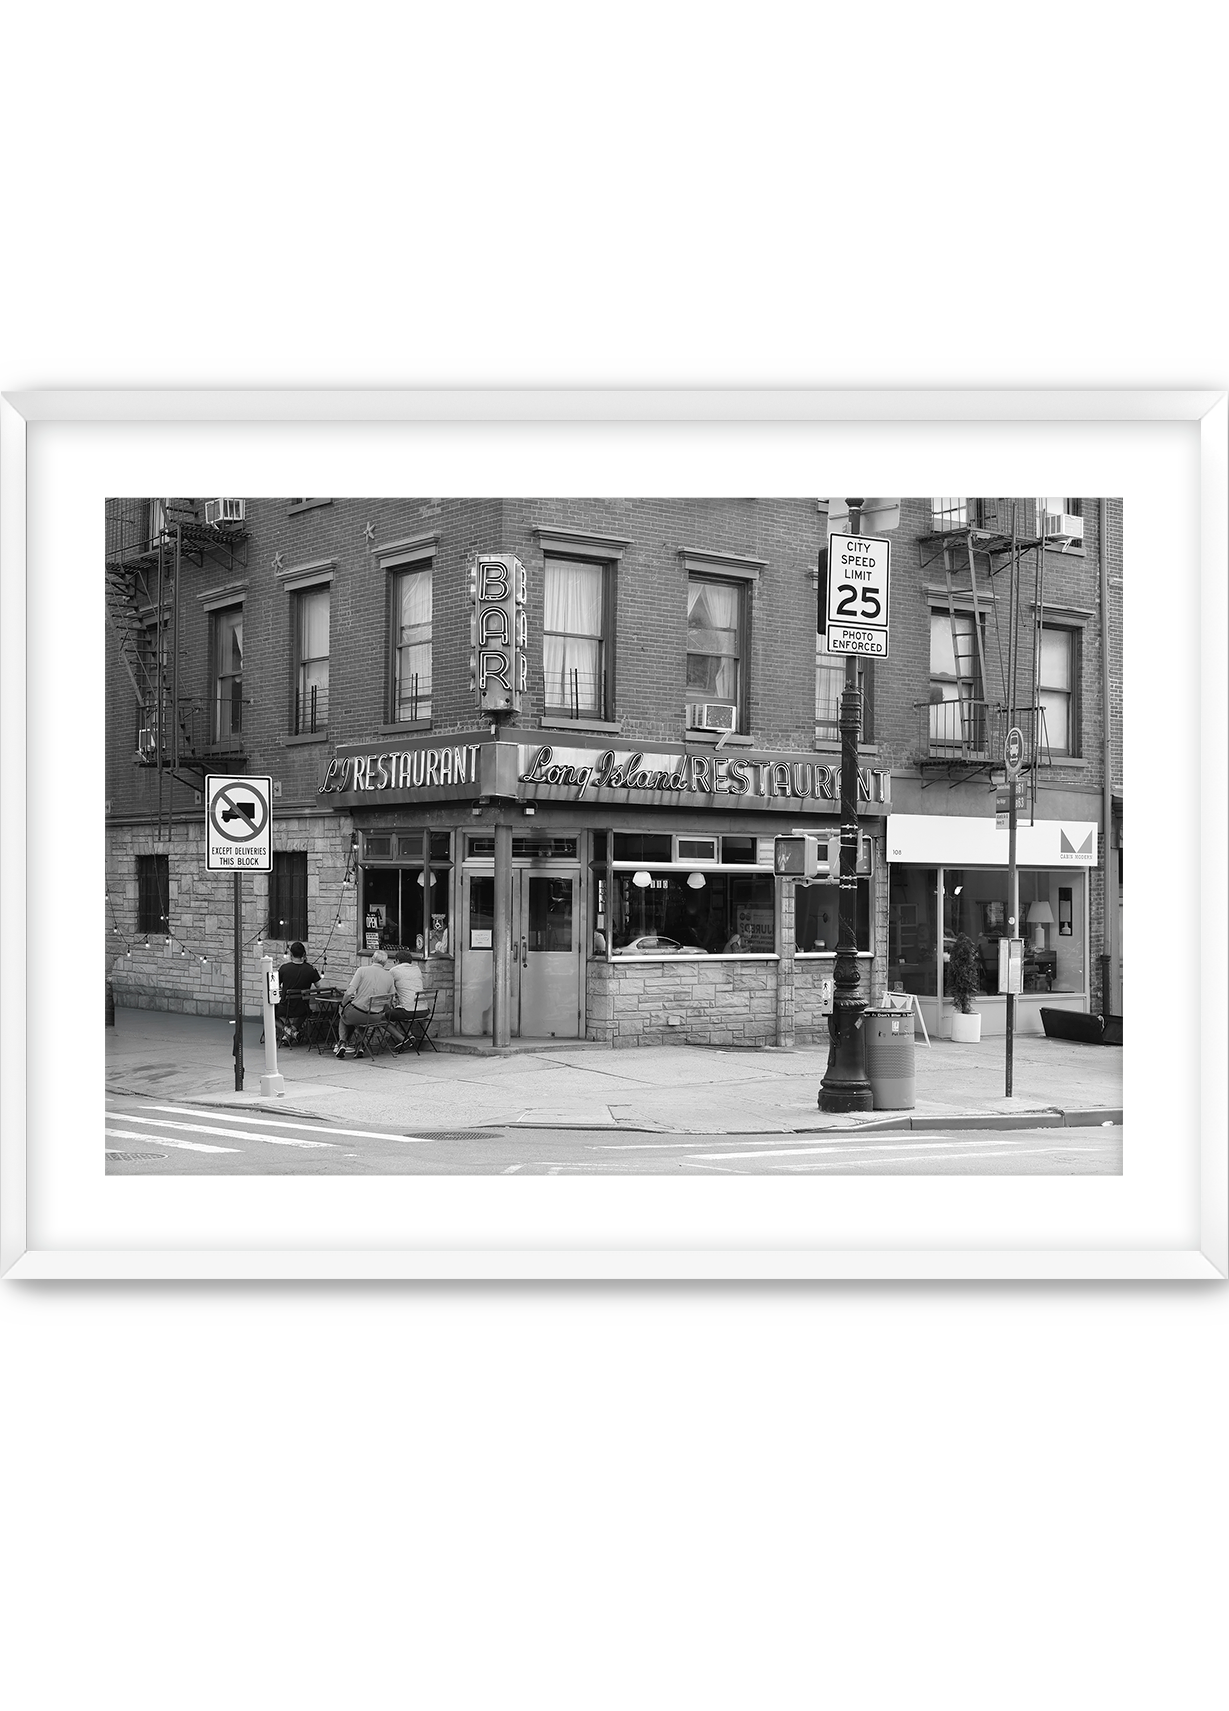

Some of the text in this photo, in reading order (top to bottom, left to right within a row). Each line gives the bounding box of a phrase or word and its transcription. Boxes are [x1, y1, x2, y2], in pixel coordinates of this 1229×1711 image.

[847, 542, 871, 553] CITY
[841, 555, 876, 567] SPEED
[845, 569, 872, 581] LIMIT
[837, 584, 881, 619] 25
[479, 562, 512, 690] BAR
[843, 631, 873, 641] PHOTO
[833, 640, 882, 652] ENFORCED
[354, 745, 480, 791] RESTAURANT
[522, 744, 594, 799] Long
[594, 749, 688, 791] Island
[211, 847, 267, 855] EXCEPT DELIVERIES
[220, 857, 259, 865] THIS BLOCK
